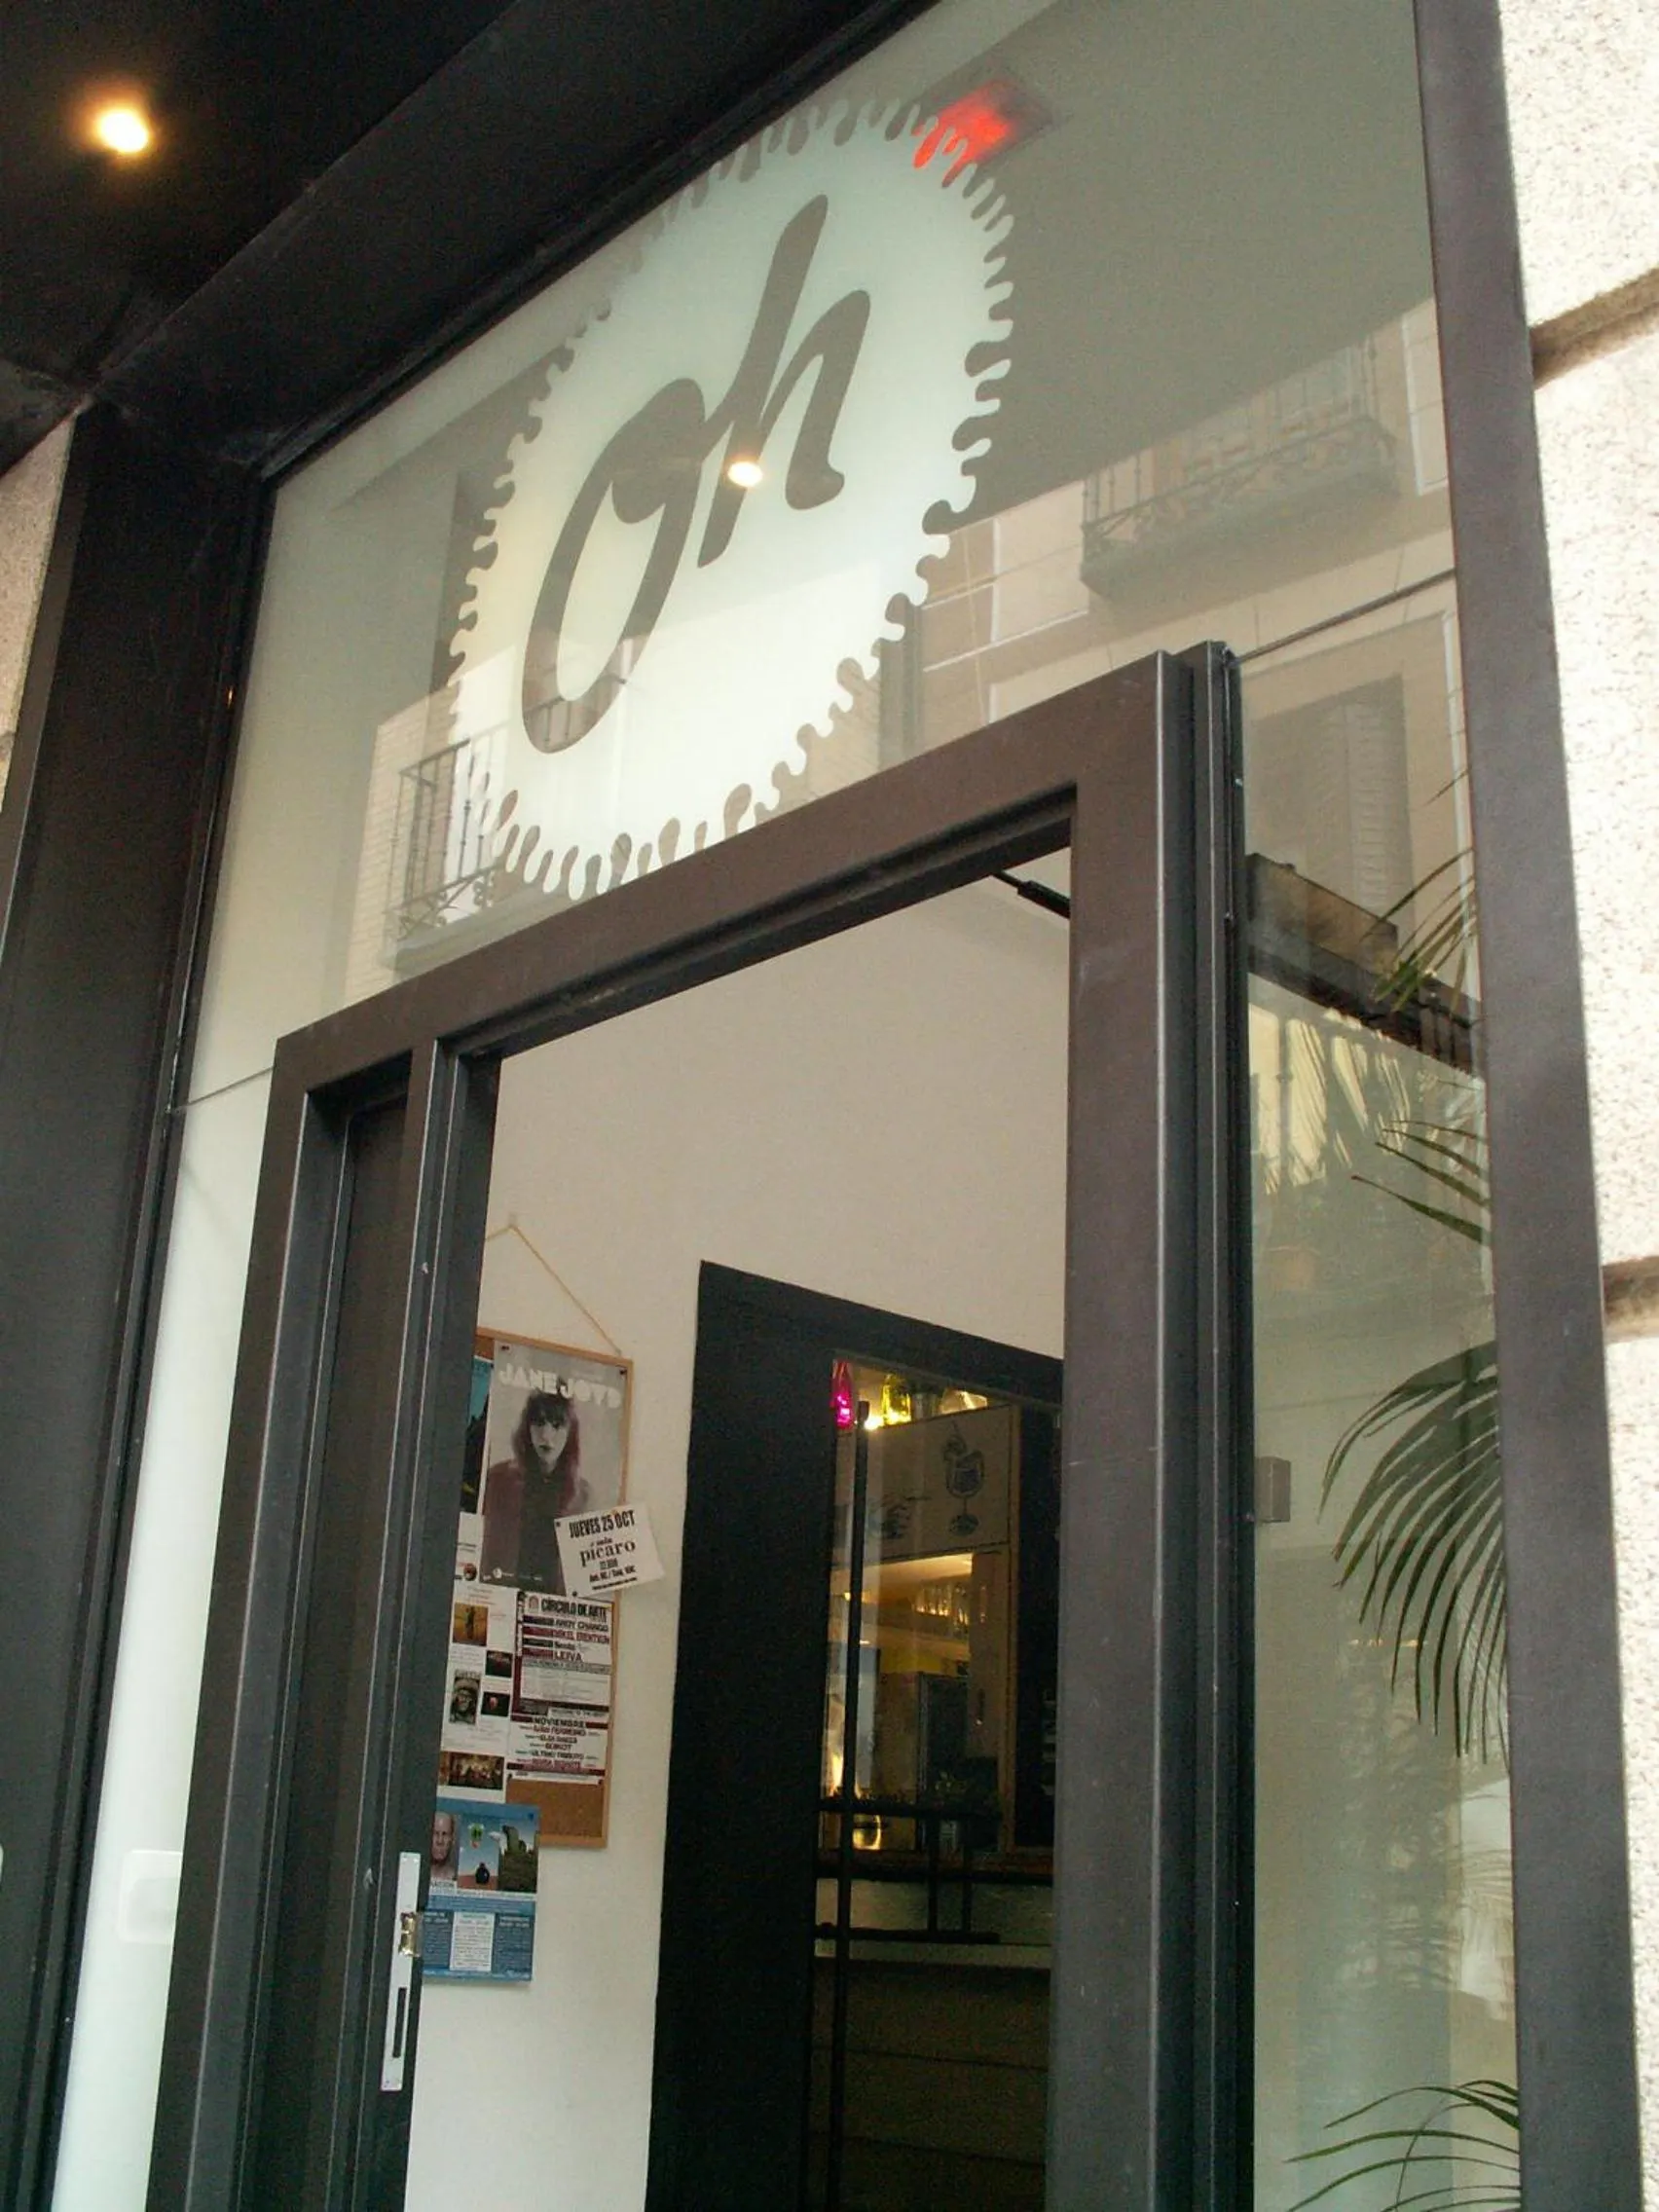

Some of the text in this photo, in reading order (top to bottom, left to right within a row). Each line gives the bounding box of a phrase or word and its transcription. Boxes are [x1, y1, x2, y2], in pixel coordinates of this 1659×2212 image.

[498, 1363, 558, 1395] JANE
[569, 1510, 636, 1538] JUEVES 25 OCT
[534, 1717, 585, 1728] NOVIEMBRE
